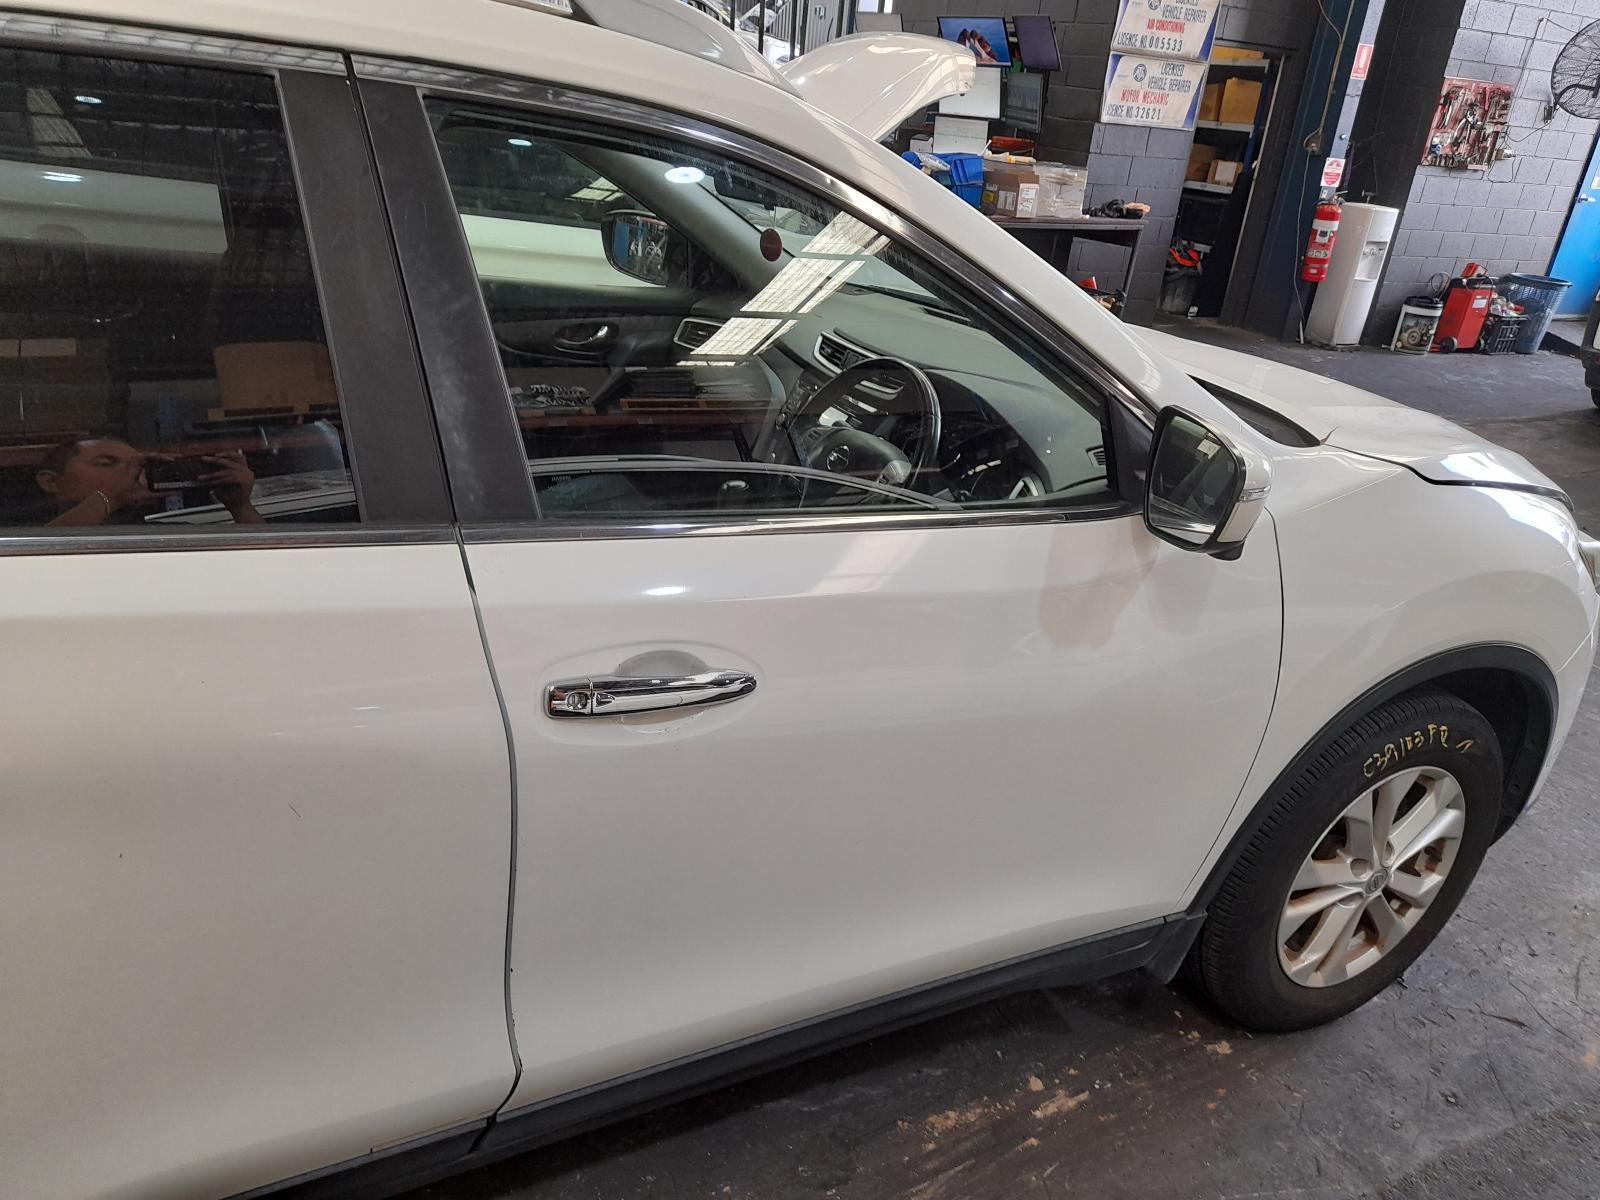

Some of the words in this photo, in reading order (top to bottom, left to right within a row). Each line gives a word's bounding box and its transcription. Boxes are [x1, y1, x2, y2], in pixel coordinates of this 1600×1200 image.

[1161, 62, 1184, 76] LICENSED
[1120, 88, 1140, 103] MOTOR
[1141, 90, 1169, 105] MECHANIC
[1135, 106, 1160, 120] 32621
